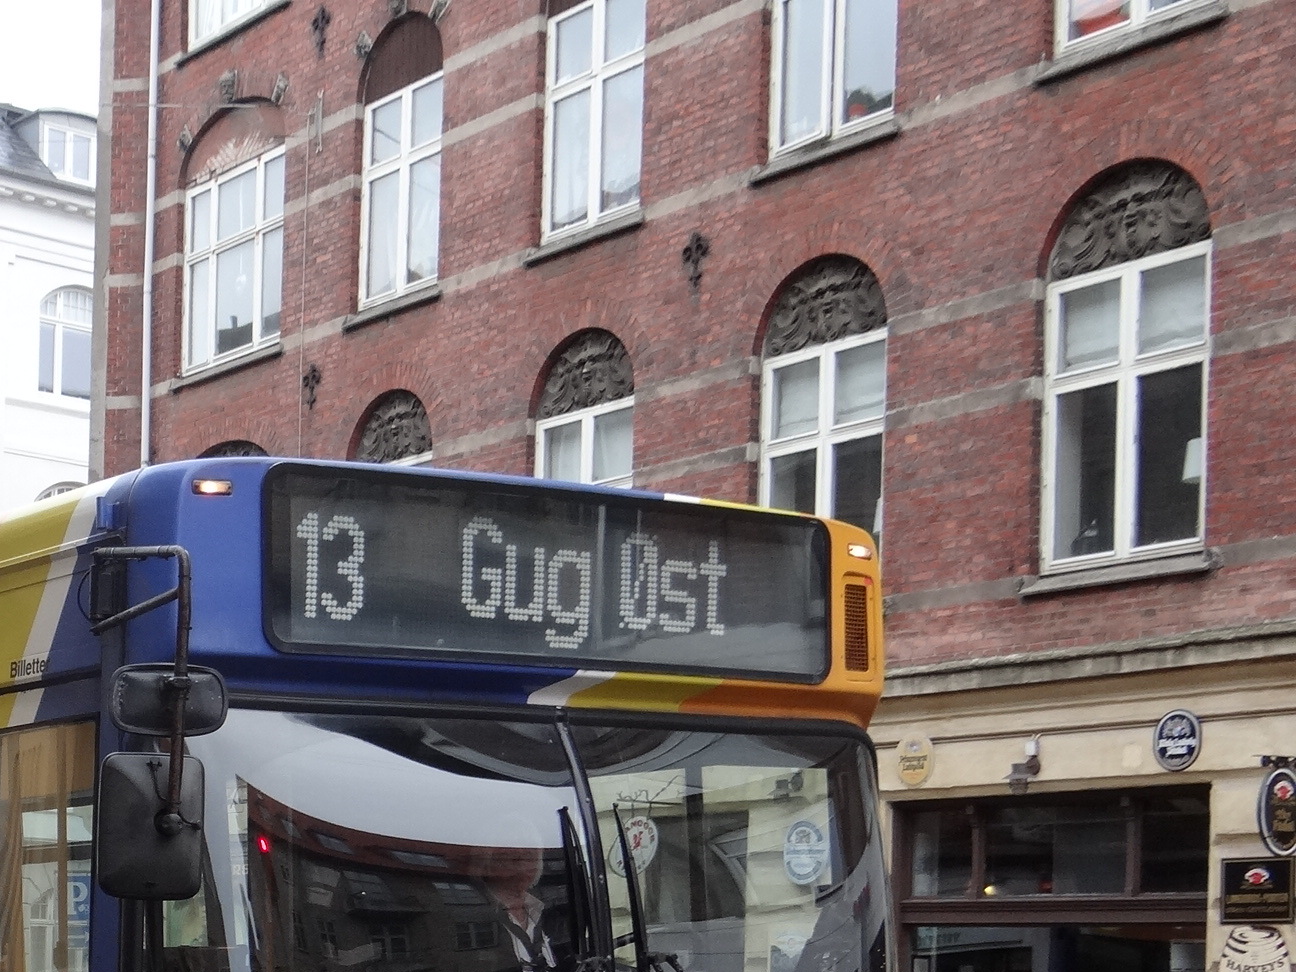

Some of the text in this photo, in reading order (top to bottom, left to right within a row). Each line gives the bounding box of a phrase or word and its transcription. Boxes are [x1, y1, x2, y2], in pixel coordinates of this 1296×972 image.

[296, 512, 727, 649] 13 Gug Øst
